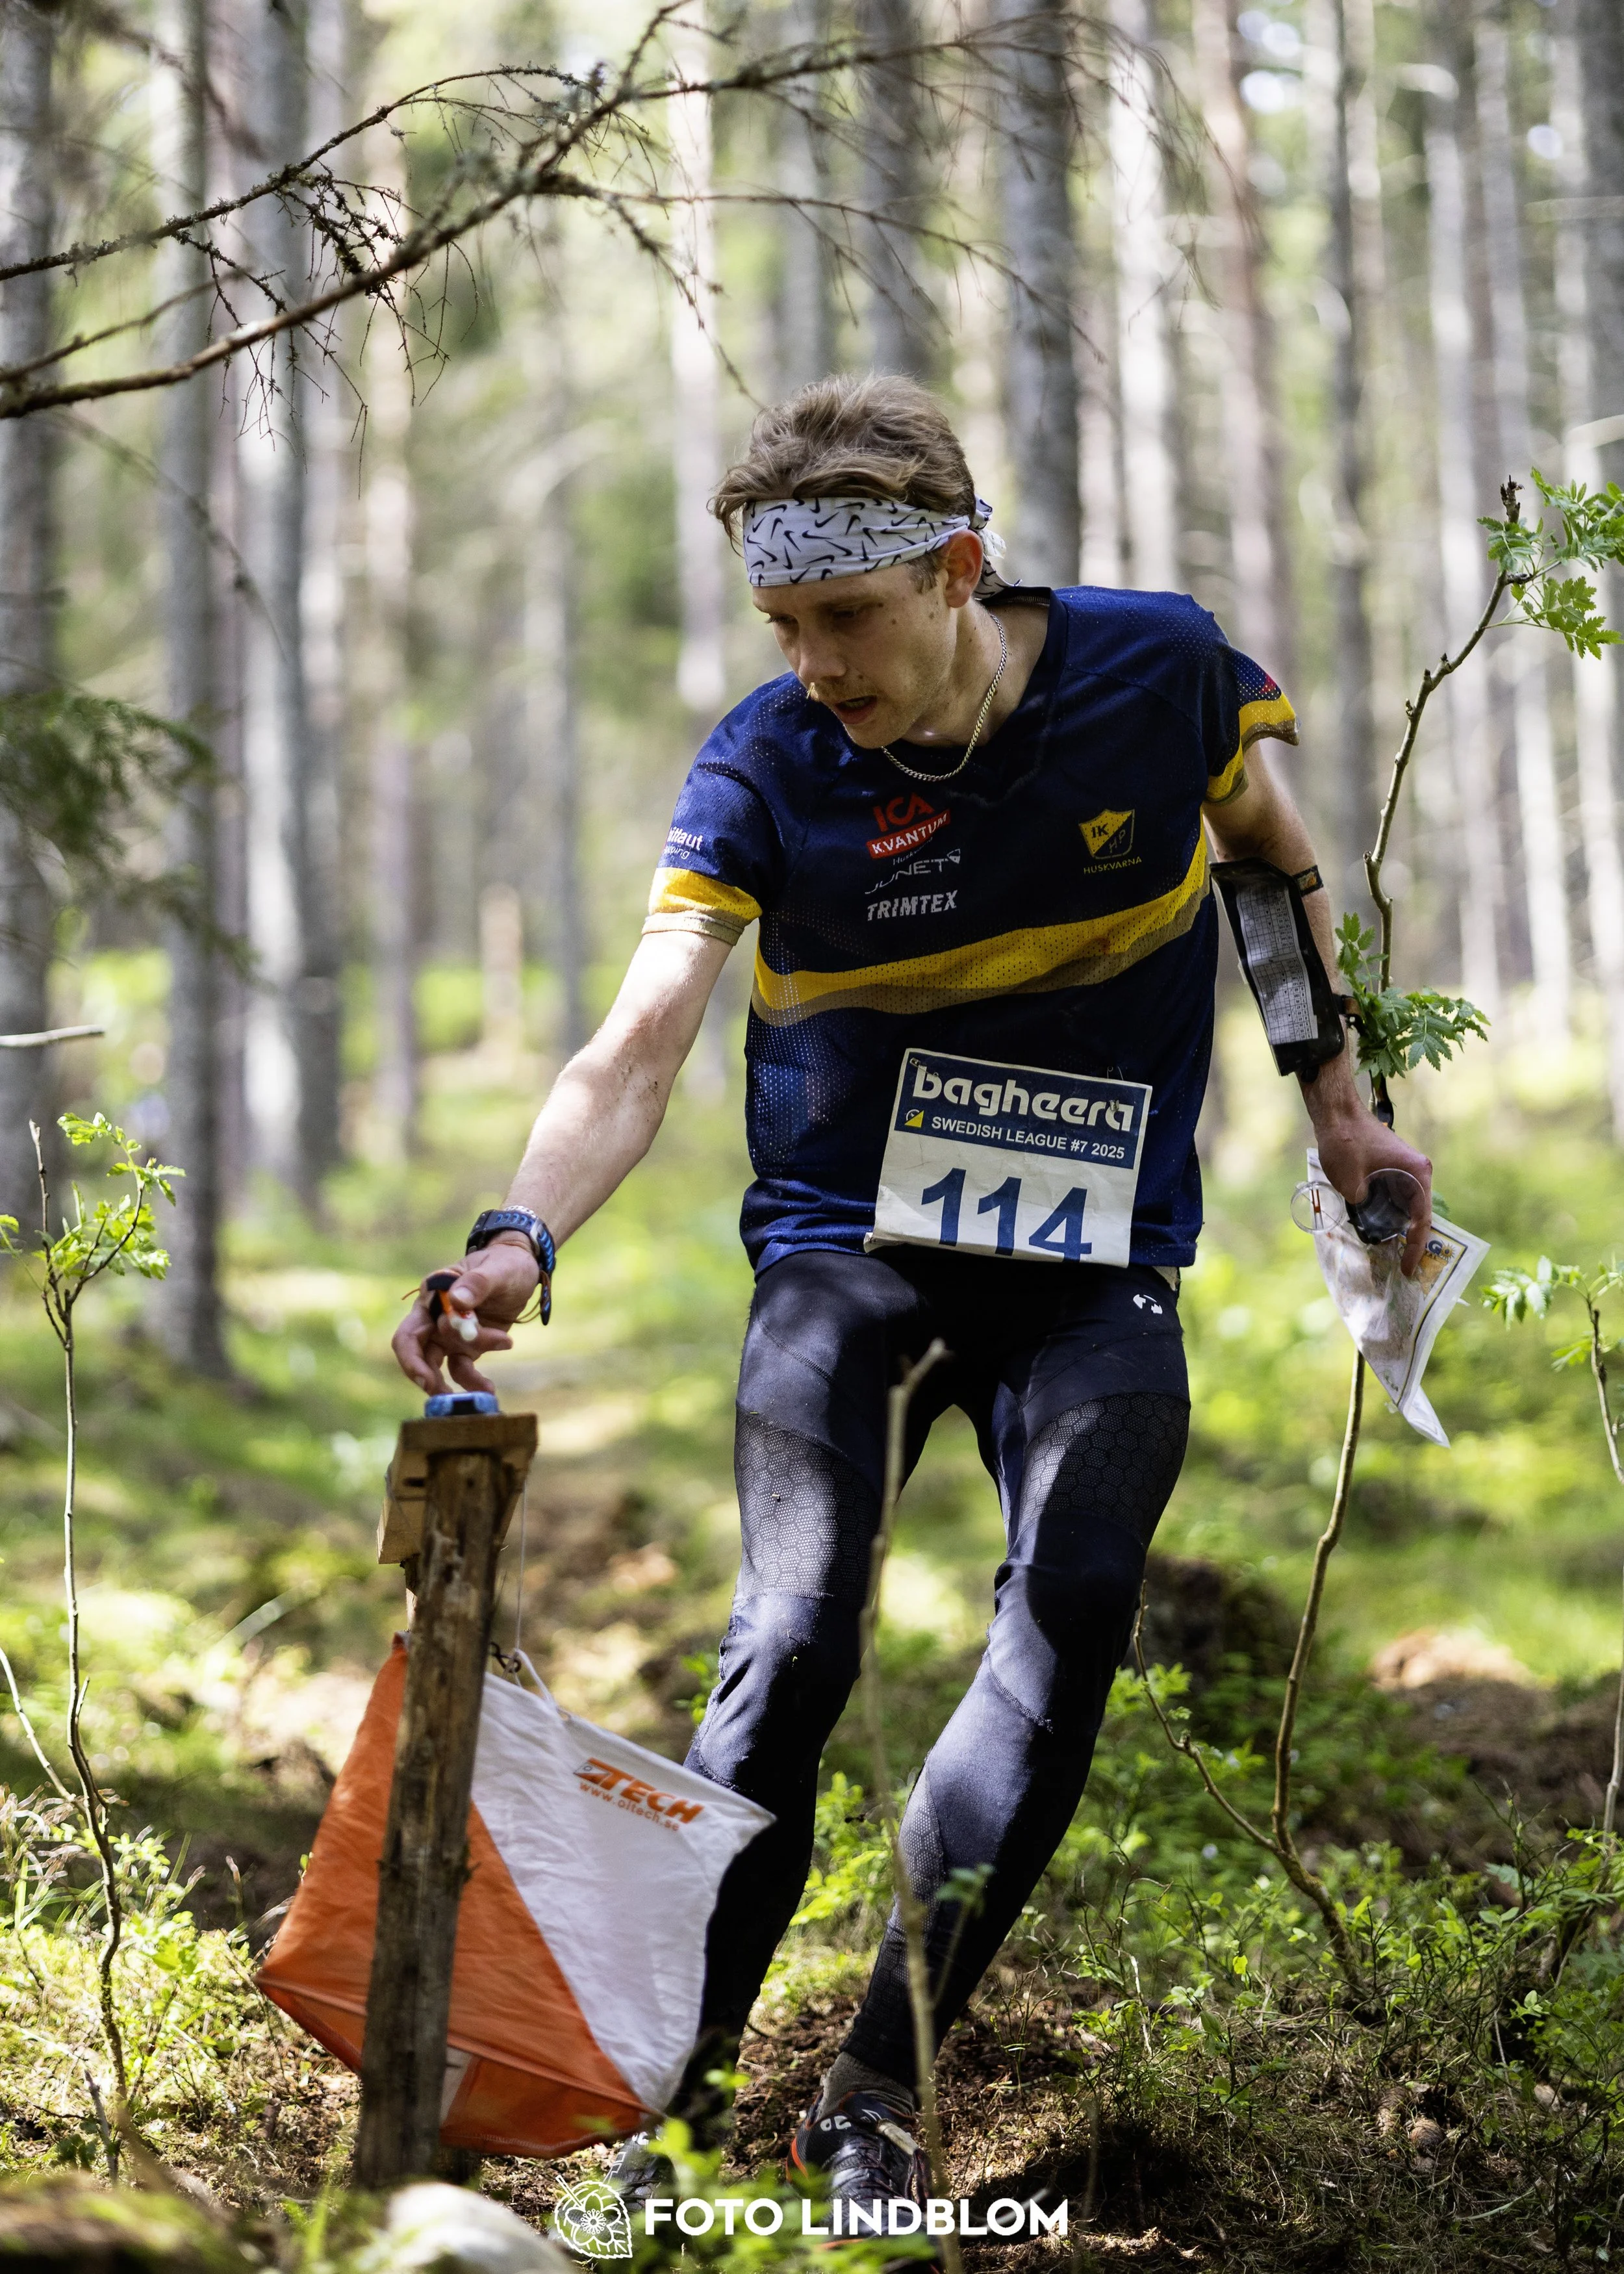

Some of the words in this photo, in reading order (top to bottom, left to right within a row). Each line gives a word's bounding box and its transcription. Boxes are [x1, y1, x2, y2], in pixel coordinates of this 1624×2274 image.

[874, 793, 934, 832] ICA
[1092, 823, 1108, 838] IK
[872, 813, 947, 854] KVANTUM
[1109, 830, 1126, 853] HP
[1084, 856, 1142, 875] HUSKVARNA
[867, 889, 958, 921] TRIMTEX
[913, 1066, 1134, 1132] bagheera
[932, 1116, 1002, 1140] SWEDISH
[1006, 1129, 1067, 1150] LEAGUE
[1071, 1139, 1089, 1153] #7
[1091, 1143, 1125, 1160] 2025
[921, 1167, 1092, 1264] 114
[579, 1783, 680, 1831] www.oltech.se
